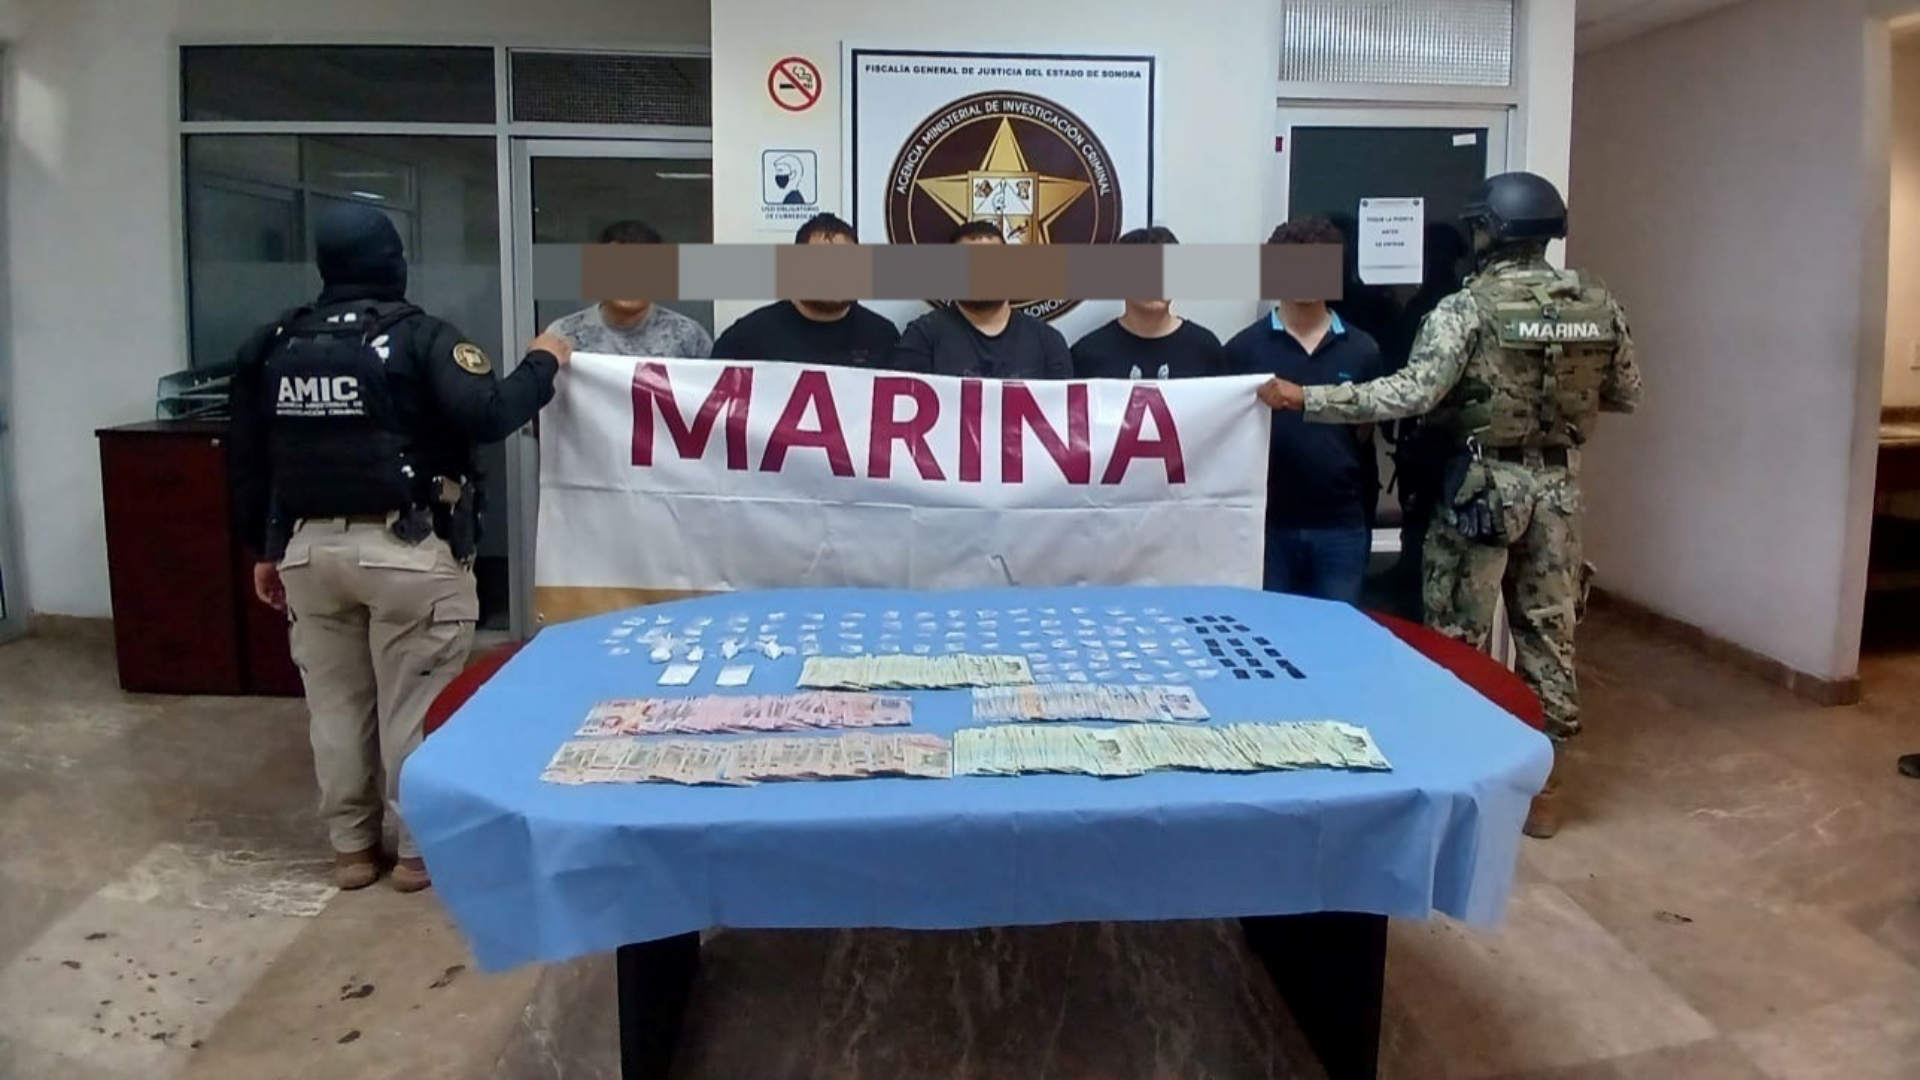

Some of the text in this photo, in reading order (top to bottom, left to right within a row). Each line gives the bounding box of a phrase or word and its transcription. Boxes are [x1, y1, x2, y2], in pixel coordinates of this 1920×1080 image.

[865, 63, 1142, 79] FISCALÍA GENERAL DE JUSTICIA DEL ESTADO DE SONORA
[896, 100, 1110, 197] AGENCIA MINISTERIAL DE INVESTIGACIÓN CRIMINAL
[1518, 321, 1600, 339] MARINA
[278, 376, 359, 402] AMIC
[631, 362, 1187, 485] MARINA
